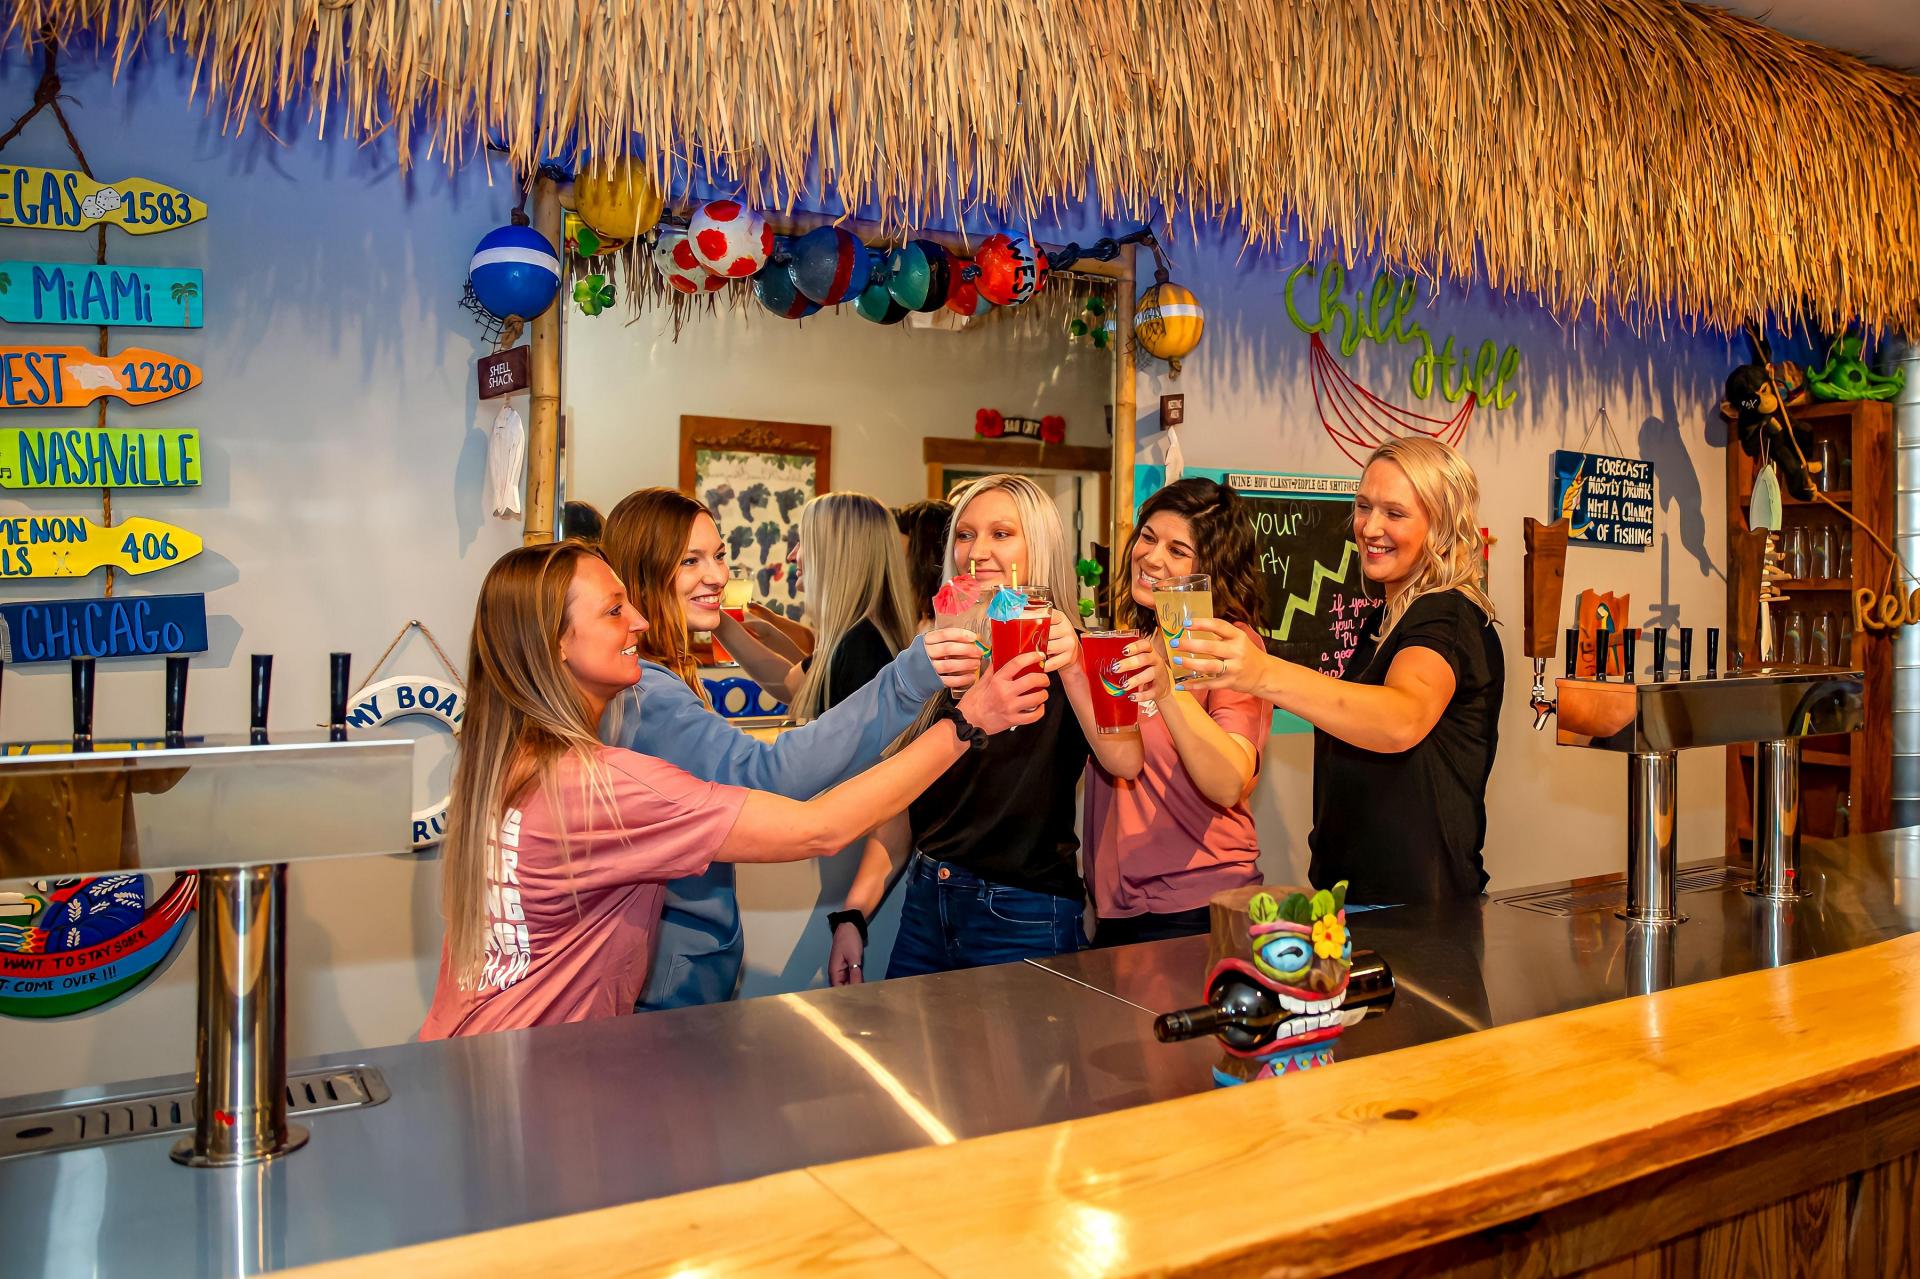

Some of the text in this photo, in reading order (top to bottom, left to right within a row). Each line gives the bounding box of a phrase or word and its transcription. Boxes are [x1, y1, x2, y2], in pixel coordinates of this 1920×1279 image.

[120, 190, 192, 225] 1583
[1285, 260, 1418, 357] Chill
[122, 361, 191, 393] 1230
[489, 373, 513, 388] SHACK
[490, 363, 511, 377] SHELL
[1597, 458, 1648, 479] FORECAST:
[1588, 476, 1651, 500] MOSTLY DRUNK
[1611, 501, 1619, 520] A
[1622, 502, 1653, 523] CHANCE
[1249, 512, 1302, 546] your
[1597, 524, 1610, 541] OF
[120, 532, 178, 564] 406
[1329, 593, 1345, 620] if
[346, 695, 383, 728] MY
[3, 930, 147, 971] WANT TO STAY SOBER
[13, 980, 54, 993] COME
[62, 972, 99, 989] OVER
